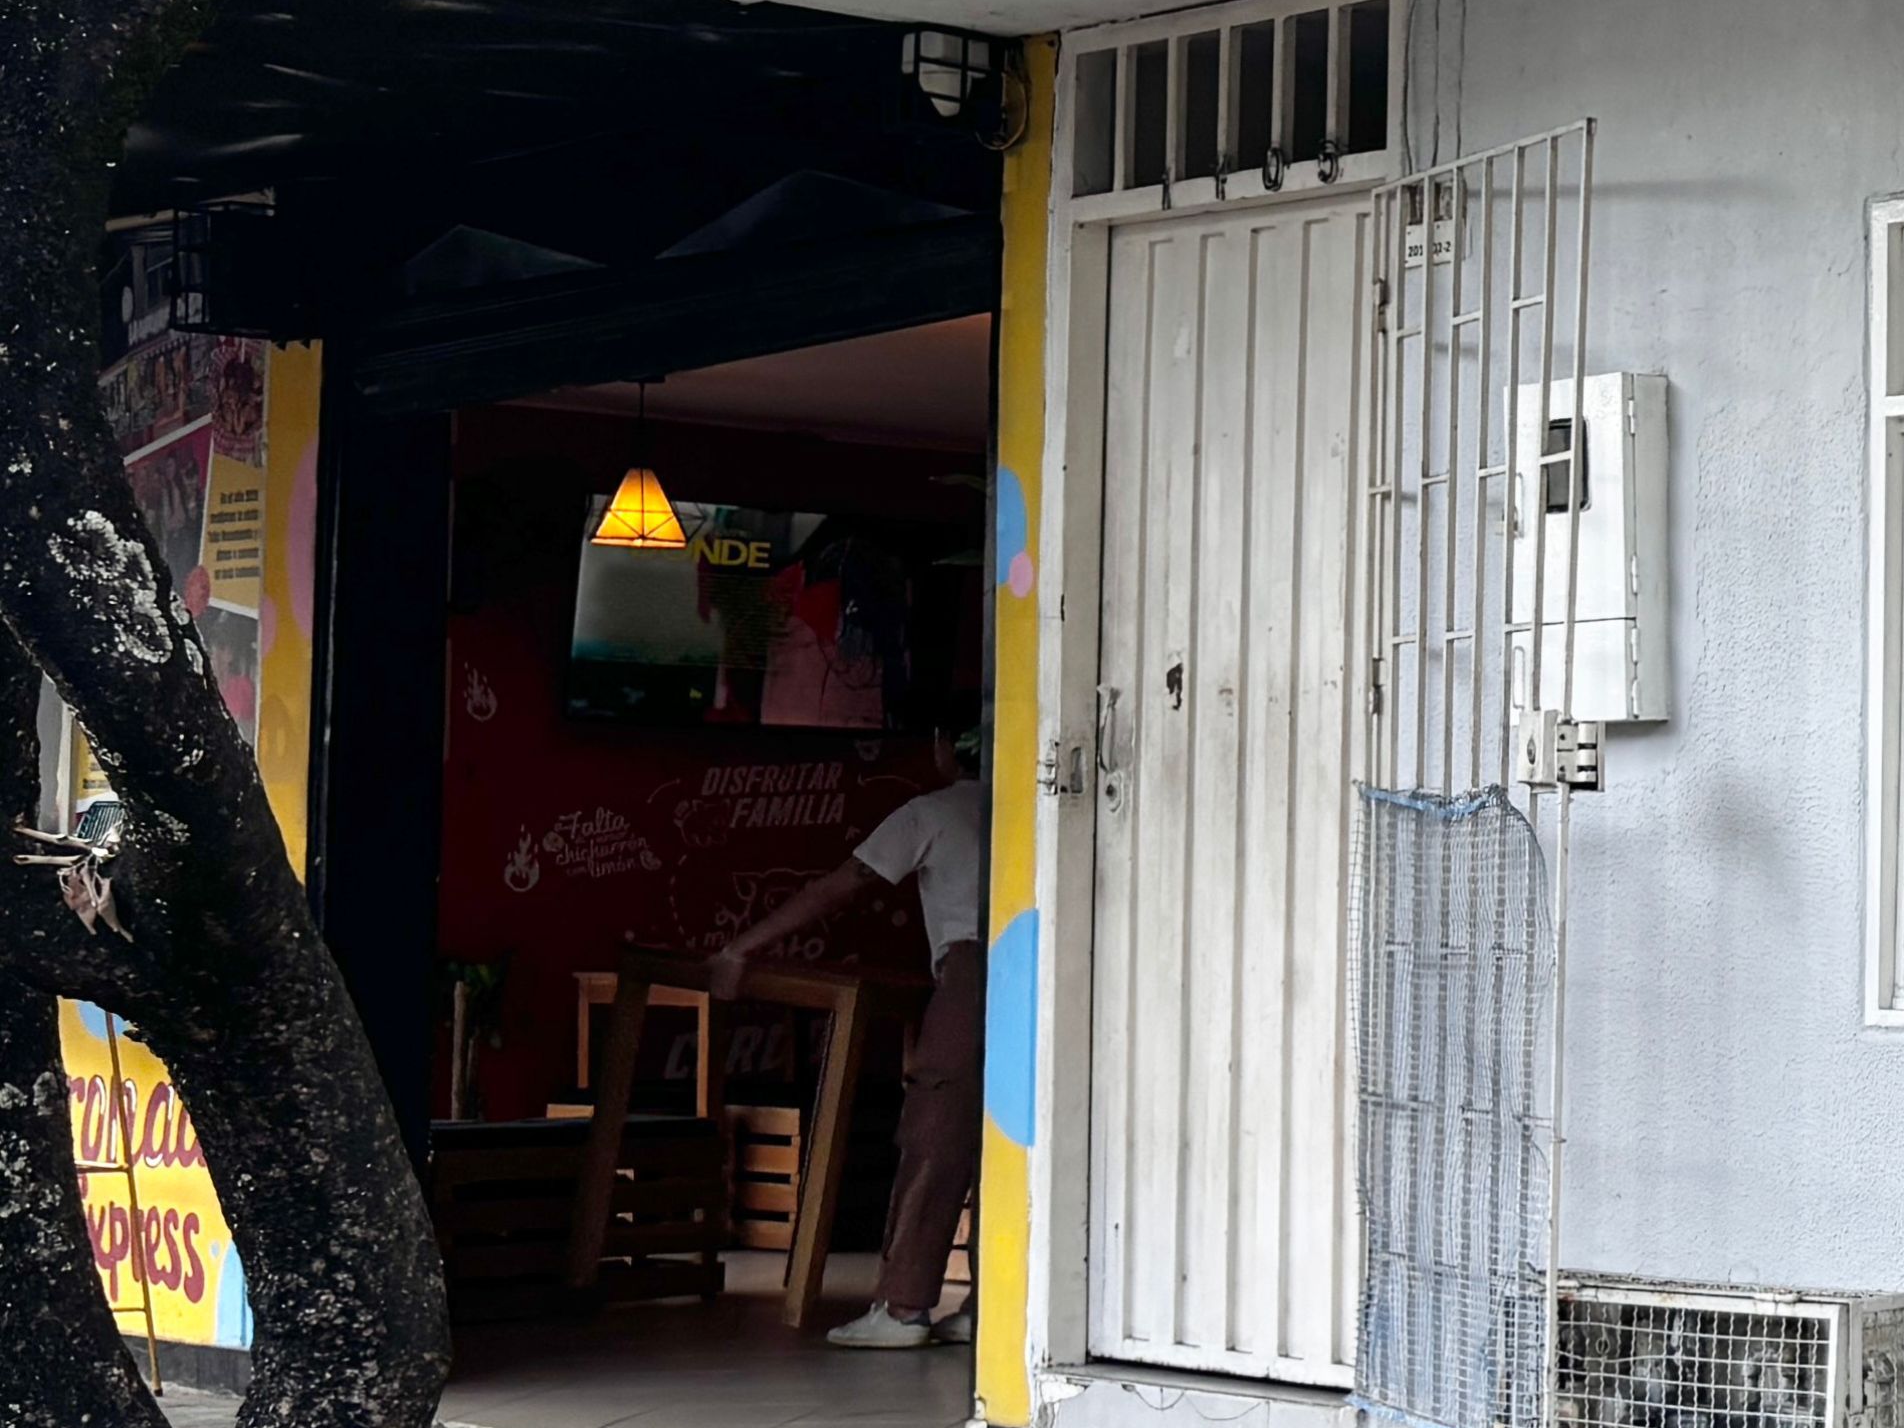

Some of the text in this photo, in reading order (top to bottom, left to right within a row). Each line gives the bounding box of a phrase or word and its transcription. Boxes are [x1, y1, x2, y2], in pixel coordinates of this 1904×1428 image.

[700, 760, 844, 797] DISFRUTAR
[728, 792, 847, 829] FAMILIA
[80, 1174, 206, 1305] xpress
